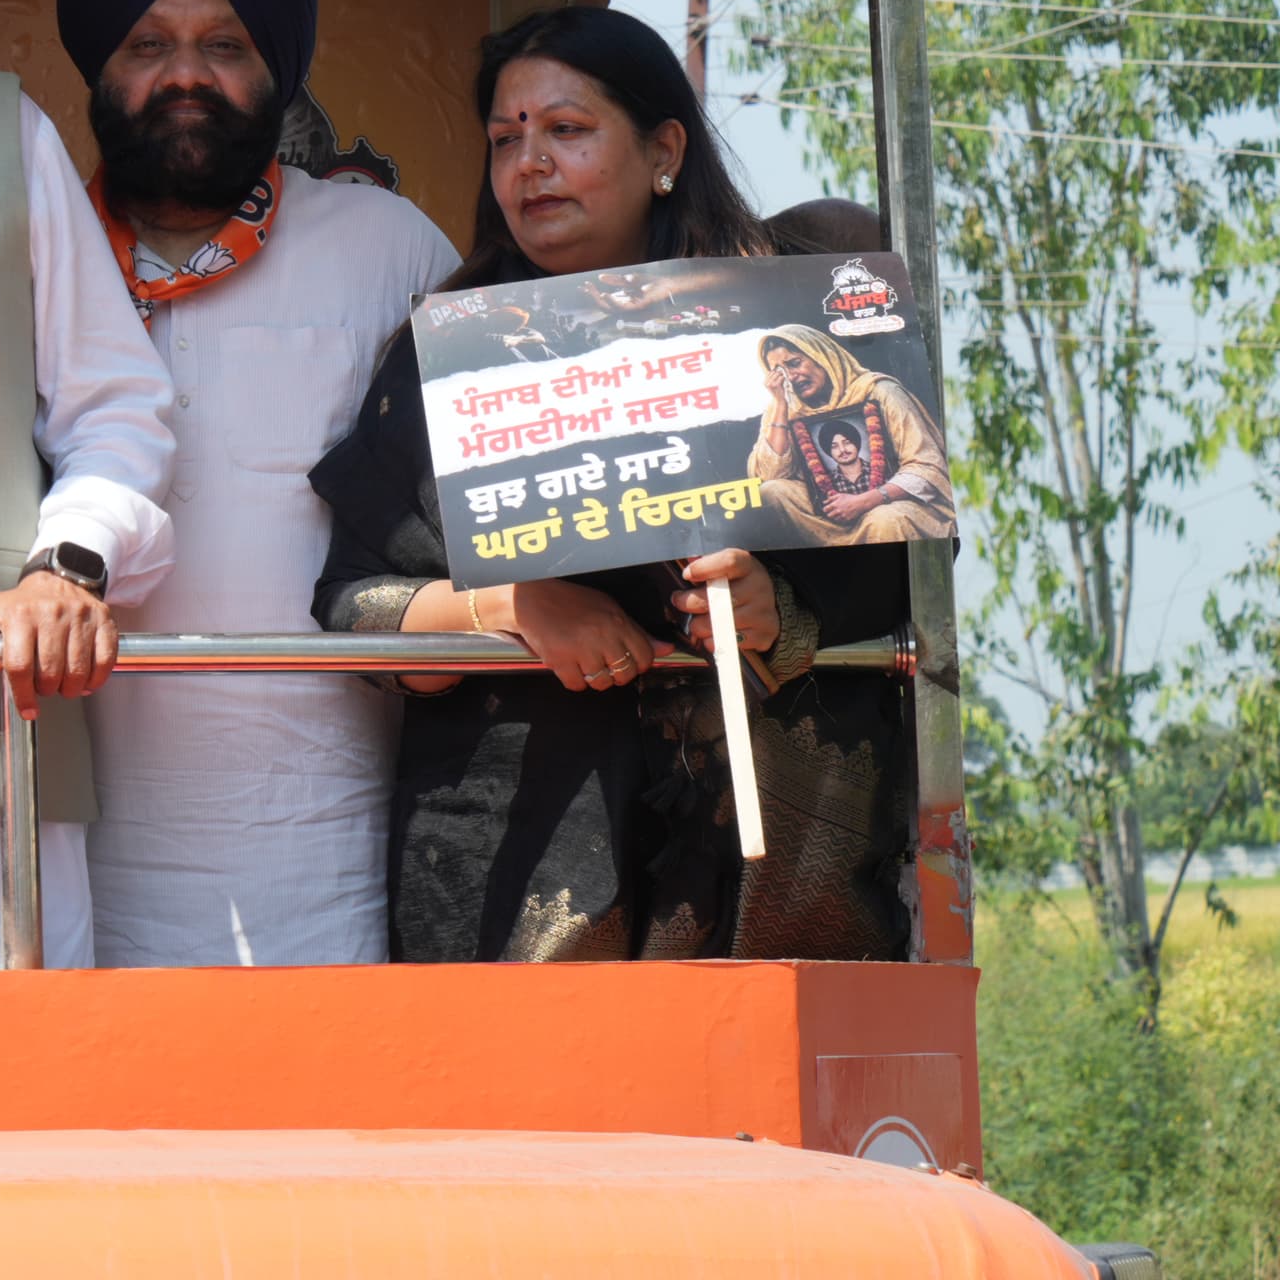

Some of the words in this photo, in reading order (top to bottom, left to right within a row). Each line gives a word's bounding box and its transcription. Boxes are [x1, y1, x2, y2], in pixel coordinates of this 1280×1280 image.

[452, 383, 541, 417] ਪੰਜਾਬ
[551, 357, 632, 398] ਦੀਆਂ
[642, 341, 713, 380] ਮਾਵਾਂ
[458, 398, 613, 458] ਮੰਗਦੀਆਂ
[623, 385, 719, 425] ਜਵਾਬ
[464, 477, 527, 523] ਬੁਝ
[535, 452, 607, 499] ਗਏ
[614, 435, 691, 482] ਸਾਡੇ
[472, 507, 563, 559] ਘਰਾਂ
[572, 497, 610, 540] ਦੇ
[618, 477, 762, 533] ਚਿਰਾਗ਼
